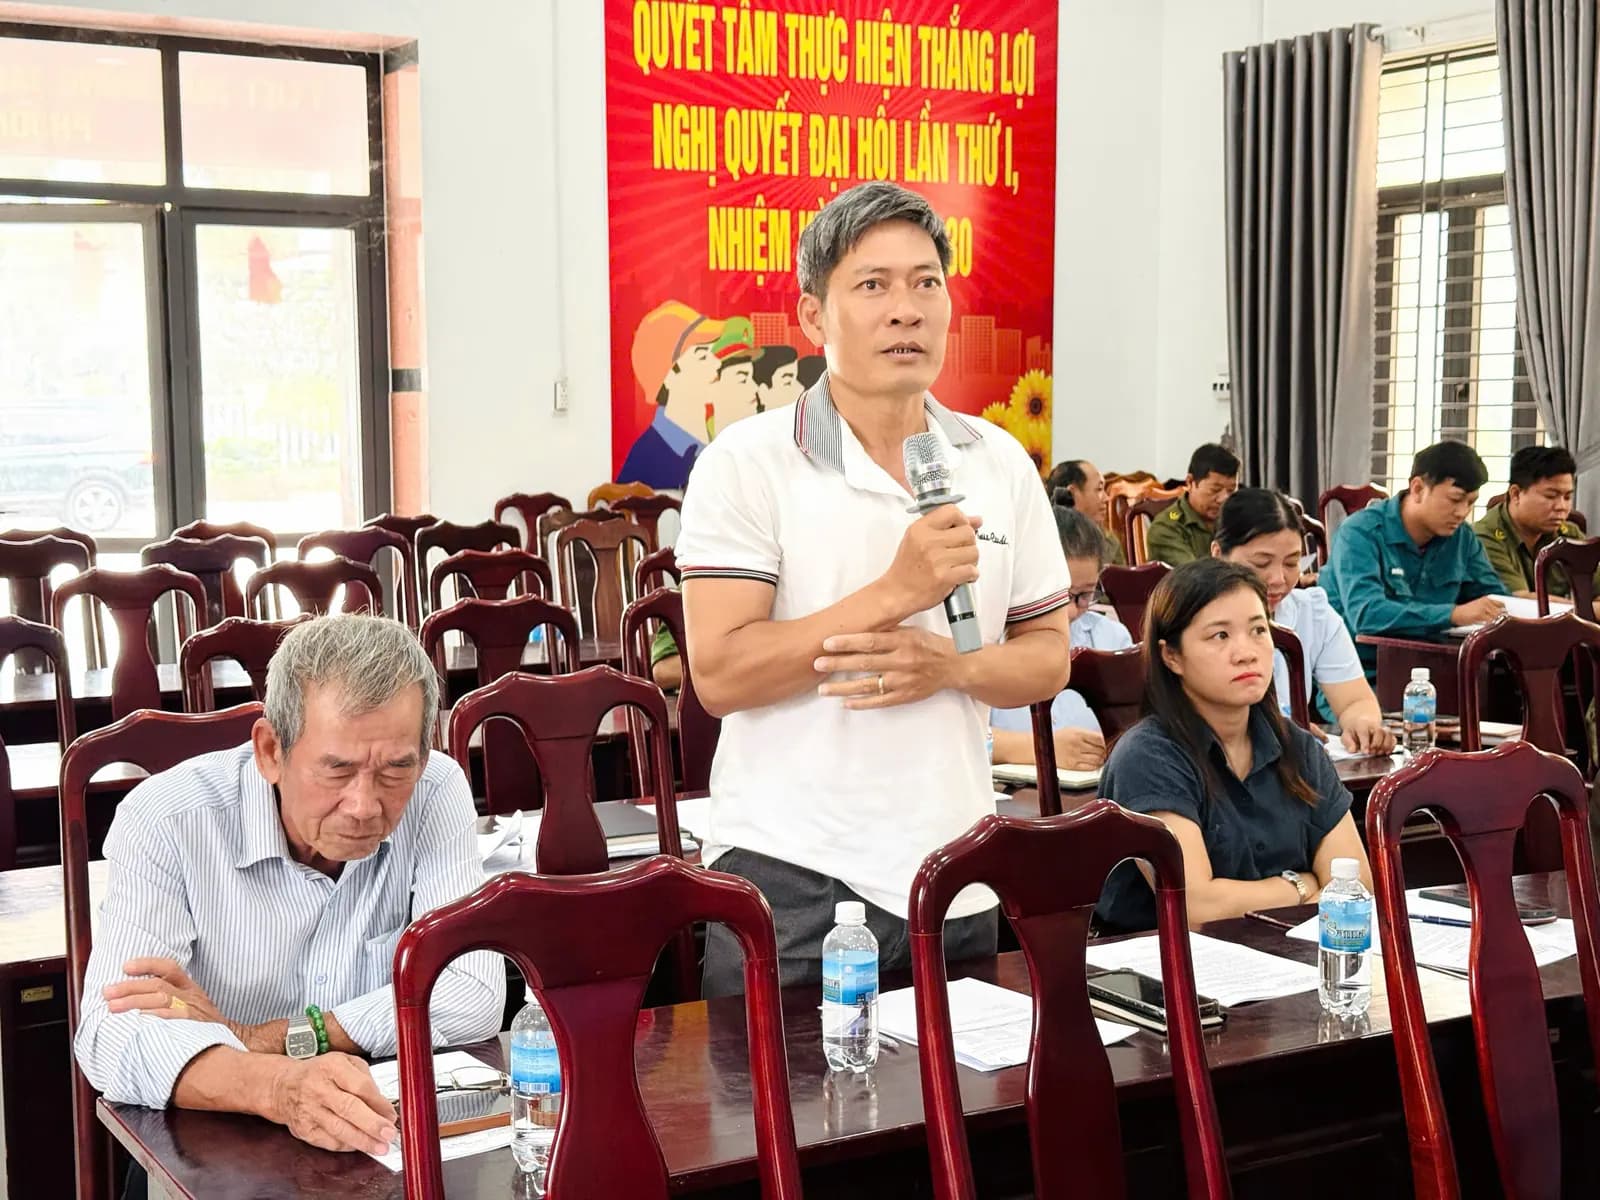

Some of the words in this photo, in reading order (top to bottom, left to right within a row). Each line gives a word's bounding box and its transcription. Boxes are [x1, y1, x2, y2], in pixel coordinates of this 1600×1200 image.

[722, 0, 778, 77] TÂM
[785, 10, 849, 96] THỰC
[855, 9, 912, 100] HIỆN
[917, 4, 994, 93] THẮNG
[1000, 28, 1035, 109] LỢI
[653, 103, 716, 187] NGHỊ
[724, 91, 803, 181] QUYẾT
[809, 114, 850, 193] ĐẠI
[903, 99, 949, 184] LẦN
[956, 112, 1001, 188] THỨ
[1005, 127, 1019, 194] I,
[708, 195, 791, 286] NHIỆM
